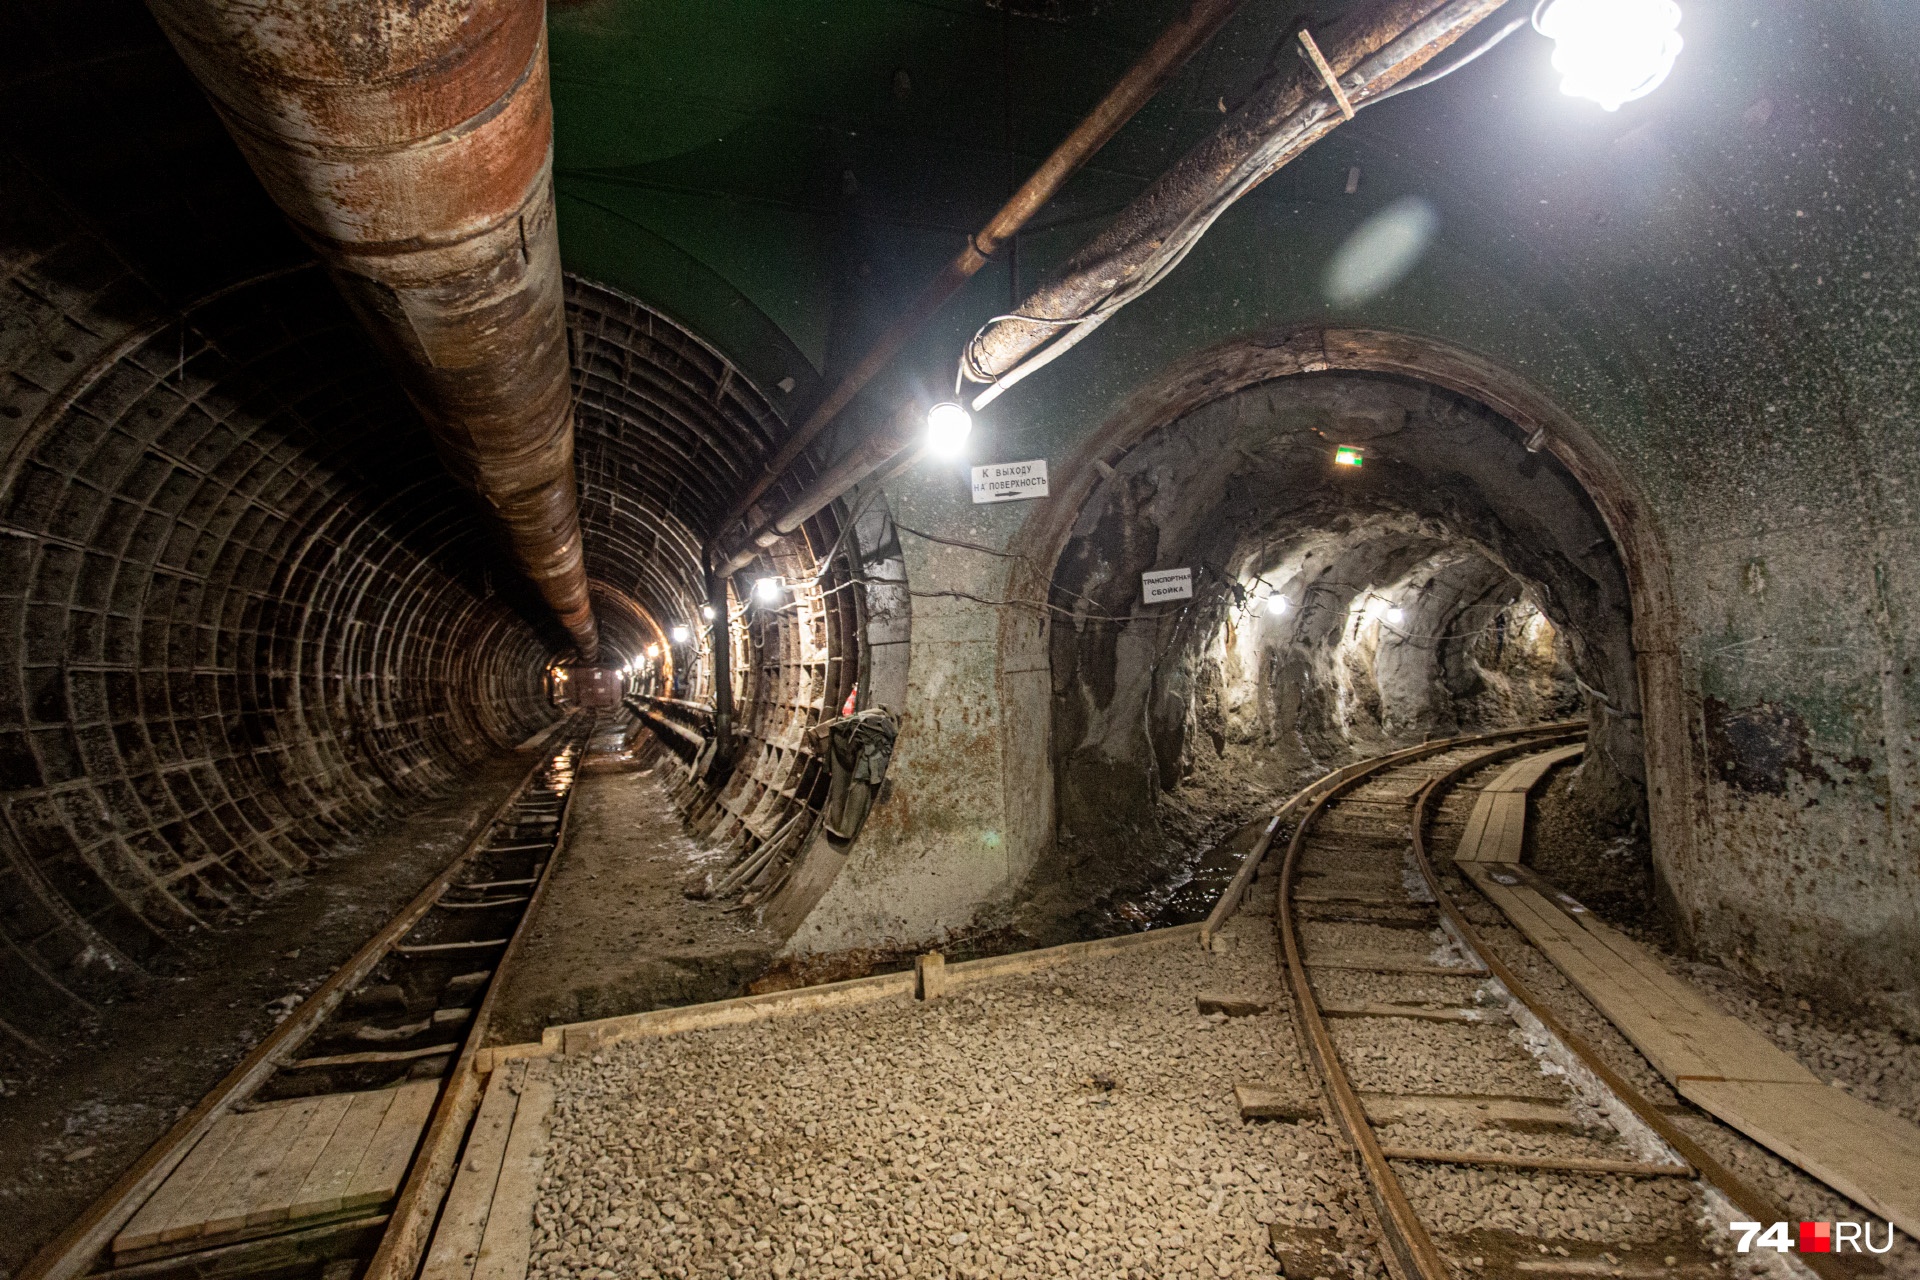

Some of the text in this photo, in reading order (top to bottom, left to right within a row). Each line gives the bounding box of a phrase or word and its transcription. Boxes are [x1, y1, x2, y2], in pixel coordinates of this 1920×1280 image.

[982, 465, 1032, 478] К ВЫХОДУ
[989, 477, 1047, 490] ПОВЕРХНОСТЬ
[1151, 586, 1184, 596] СБОЙКА
